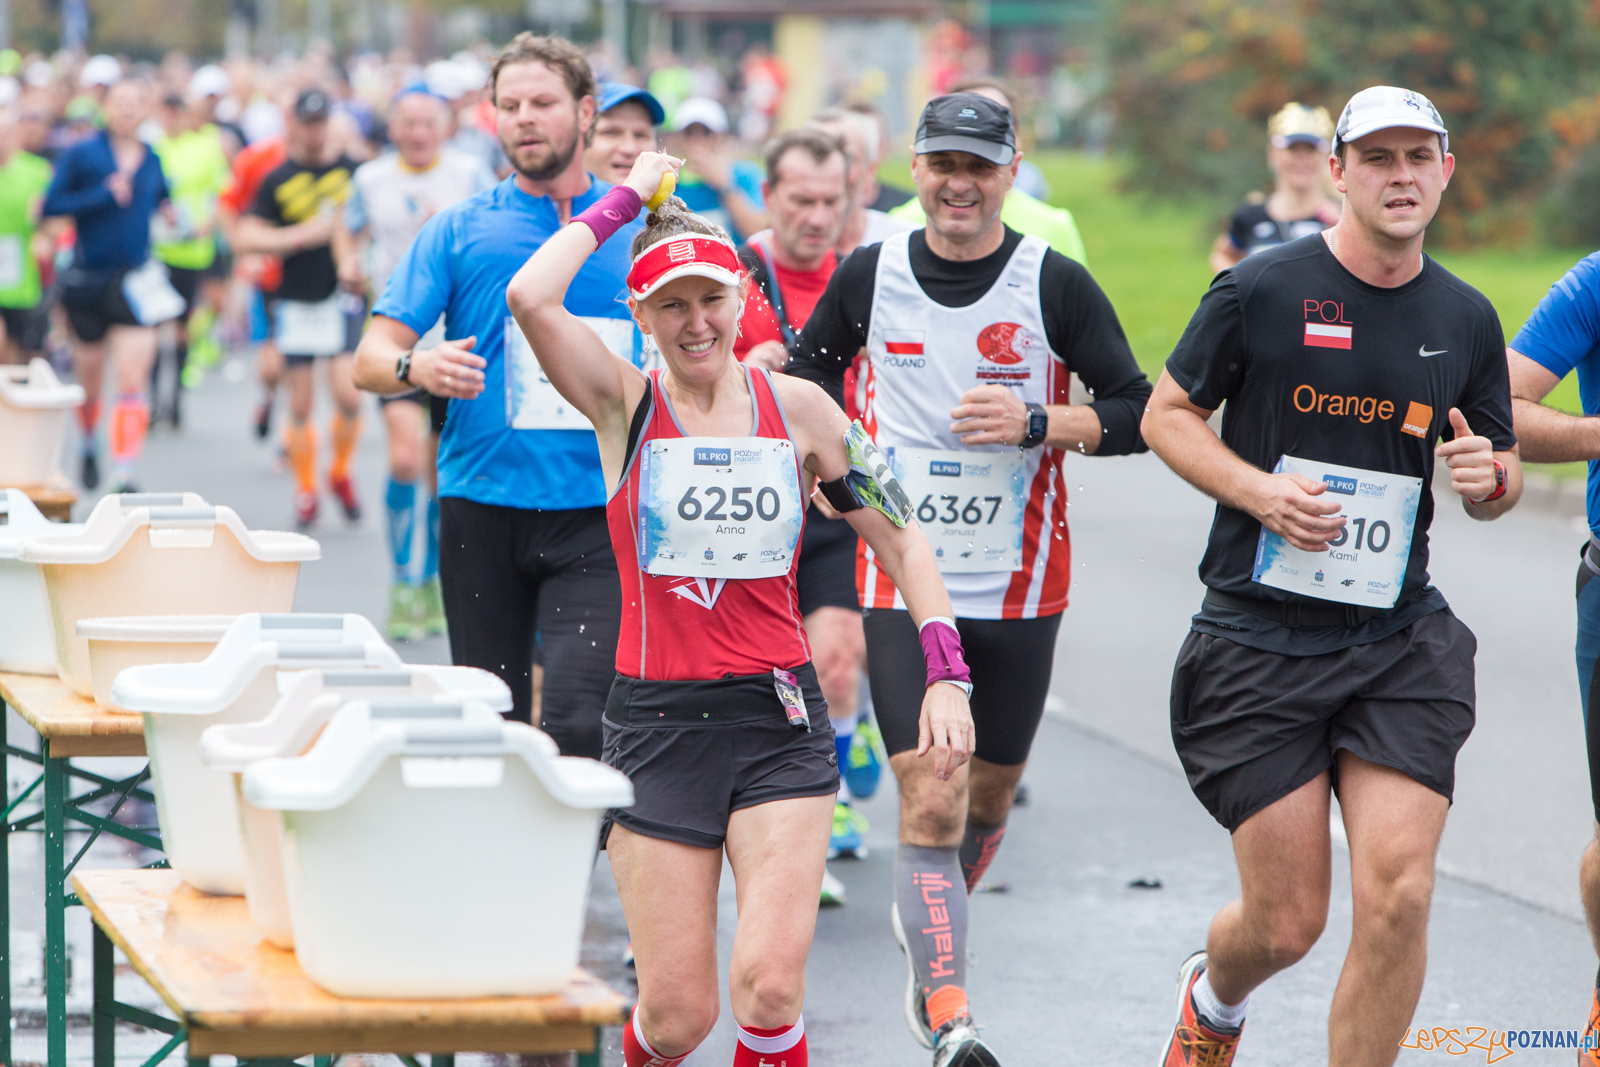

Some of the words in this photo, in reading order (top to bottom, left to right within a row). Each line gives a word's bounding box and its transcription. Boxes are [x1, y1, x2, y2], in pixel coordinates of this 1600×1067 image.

[1303, 299, 1354, 325] POL
[883, 356, 926, 369] POLAND
[1293, 384, 1395, 424] Orange
[1403, 423, 1428, 435] orange
[697, 452, 709, 461] 18.
[710, 452, 728, 461] PKO
[1337, 481, 1355, 491] PKO
[1358, 489, 1385, 498] maraton
[677, 486, 781, 522] 6250
[917, 494, 1003, 525] 6367
[715, 524, 746, 535] Anna
[942, 527, 976, 537] Janusz
[732, 553, 748, 561] 4F
[1328, 549, 1359, 562] Kamil
[1340, 579, 1355, 587] 4F
[913, 872, 954, 978] kalenji
